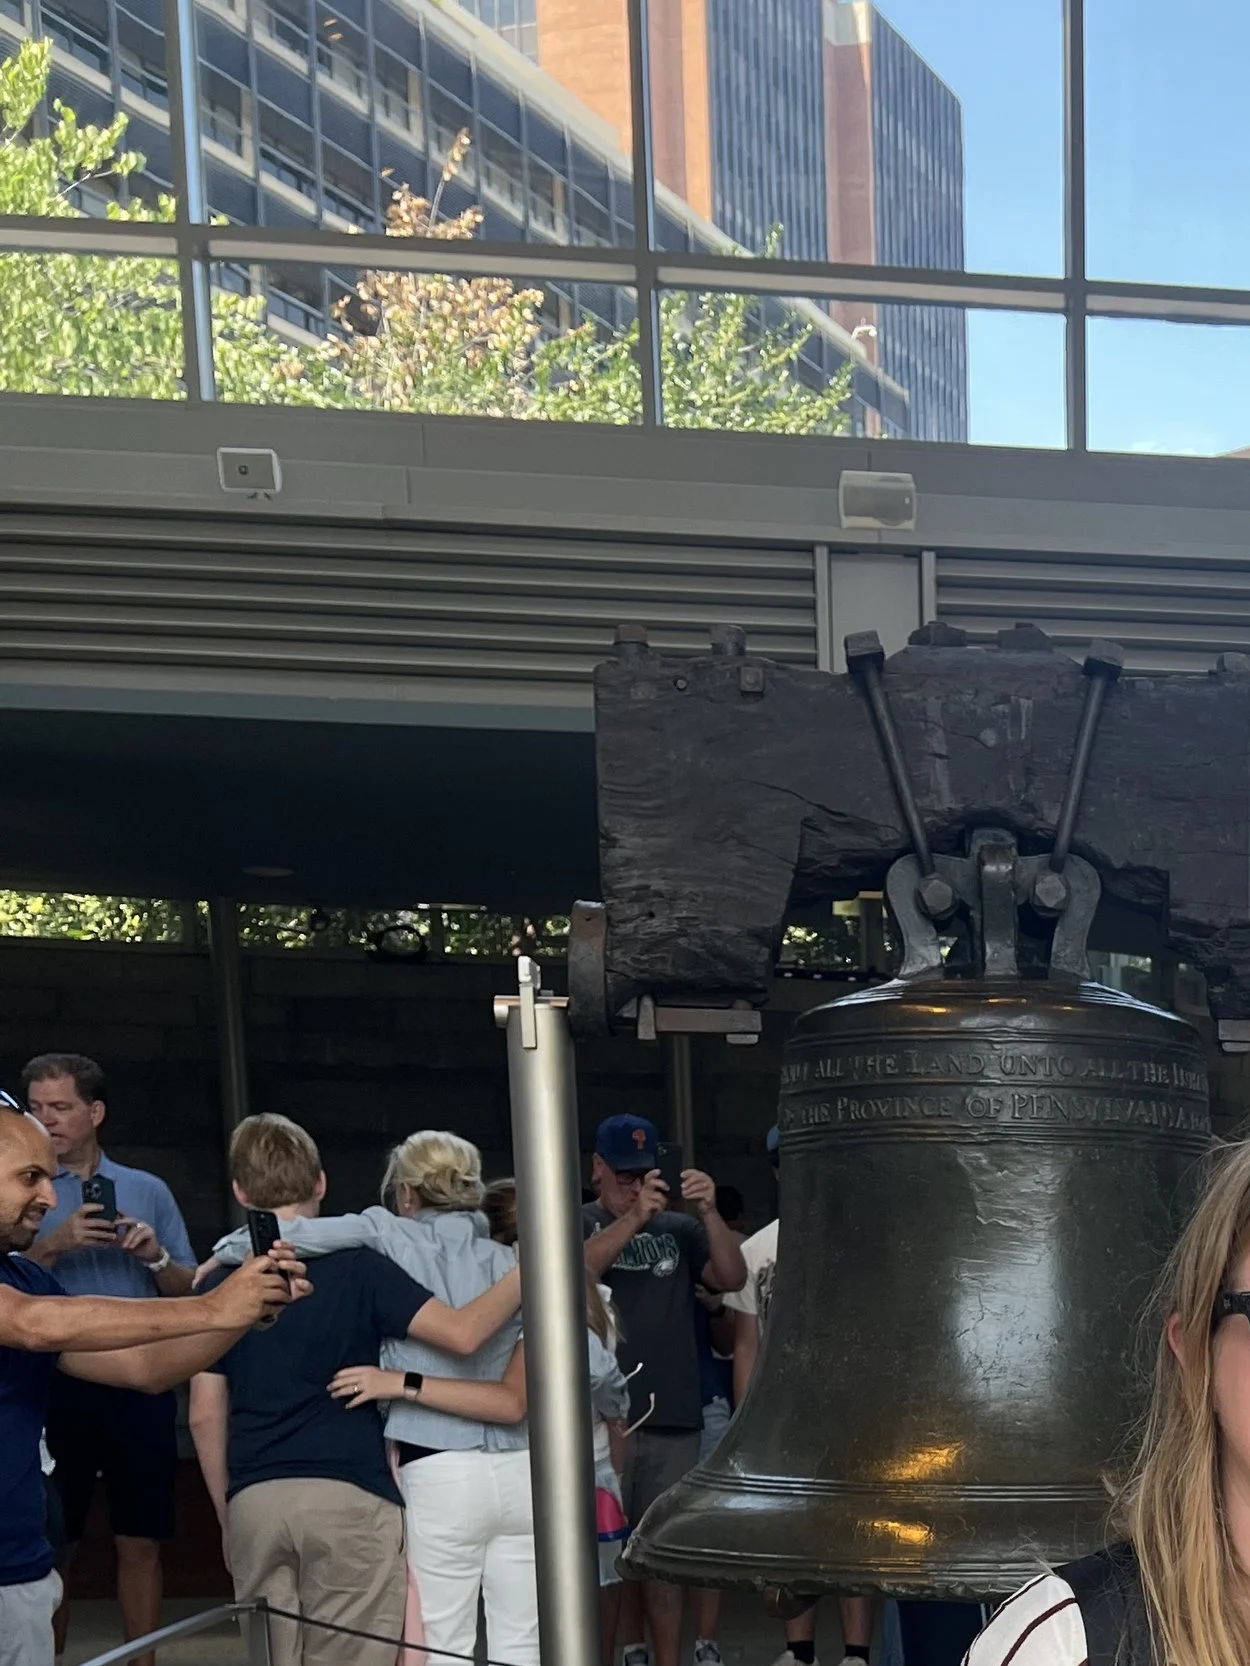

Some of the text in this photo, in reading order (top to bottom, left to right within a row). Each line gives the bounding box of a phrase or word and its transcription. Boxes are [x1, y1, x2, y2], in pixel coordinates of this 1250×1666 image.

[905, 1049, 985, 1076] LAND
[1000, 1053, 1077, 1077] UNTO
[837, 1096, 954, 1124] PROVINCE
[966, 1097, 1002, 1119] OF
